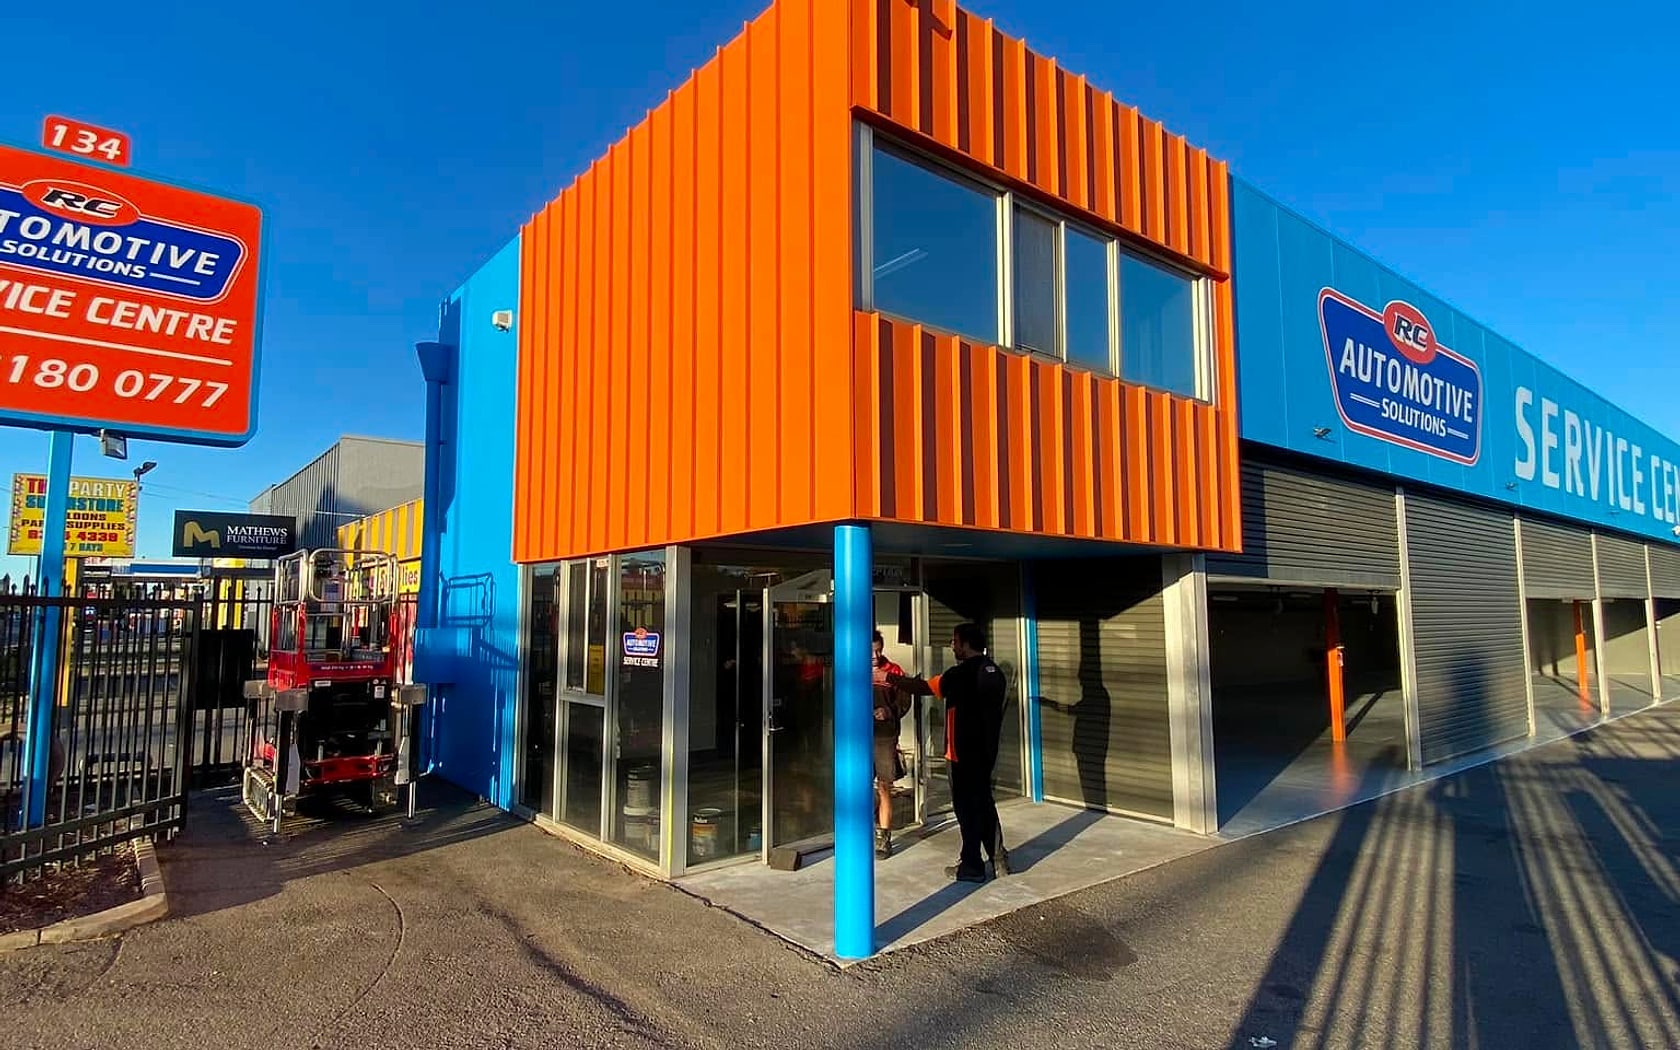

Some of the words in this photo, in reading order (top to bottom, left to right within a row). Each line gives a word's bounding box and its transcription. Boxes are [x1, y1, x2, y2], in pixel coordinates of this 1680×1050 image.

[52, 124, 122, 160] 134
[1, 239, 146, 279] SOLUTIONS
[86, 296, 238, 345] CENTRE
[1394, 311, 1428, 352] RC
[114, 369, 229, 408] 0777
[1339, 338, 1474, 423] AUTOMOTIVE
[1381, 399, 1447, 437] SOLUTIONS
[1515, 385, 1646, 516] SERVICE
[69, 480, 125, 498] PARTY
[66, 521, 125, 531] SUPPLIES
[226, 535, 287, 545] FURNITURE
[227, 525, 288, 537] MATHEWS
